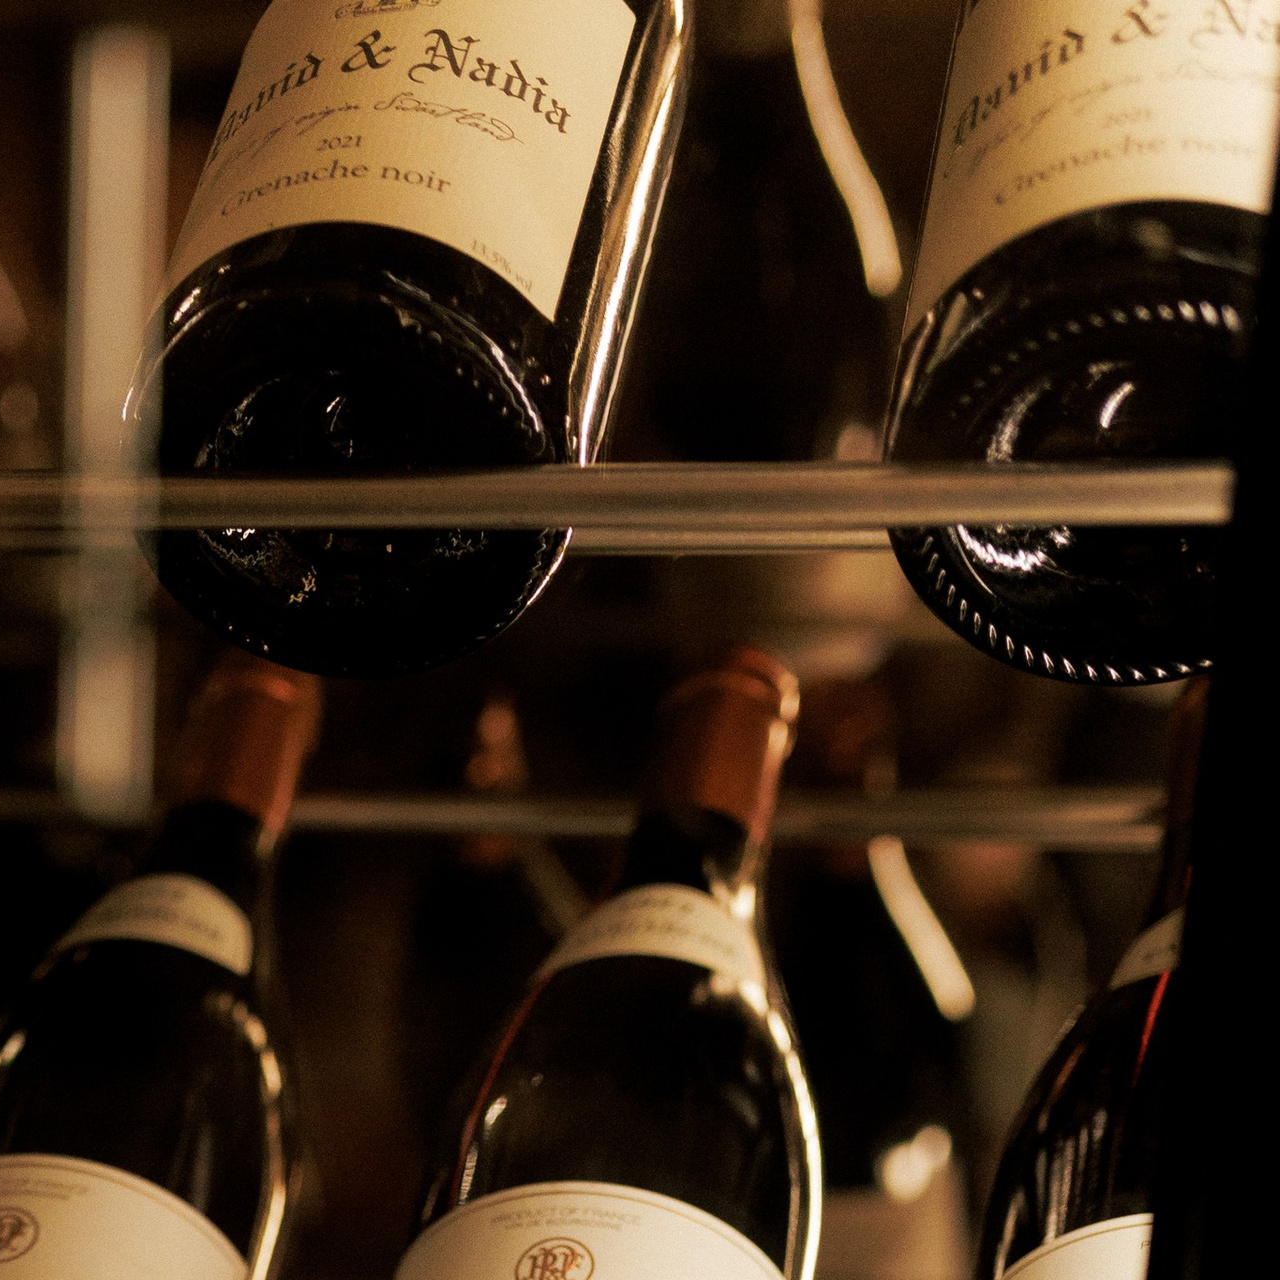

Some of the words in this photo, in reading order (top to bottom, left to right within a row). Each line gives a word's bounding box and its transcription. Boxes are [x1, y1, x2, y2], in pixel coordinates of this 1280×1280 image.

[340, 29, 398, 74] &
[407, 28, 572, 134] Nadia
[317, 135, 363, 152] 2021
[221, 158, 369, 217] Grenache
[380, 165, 452, 194] noir
